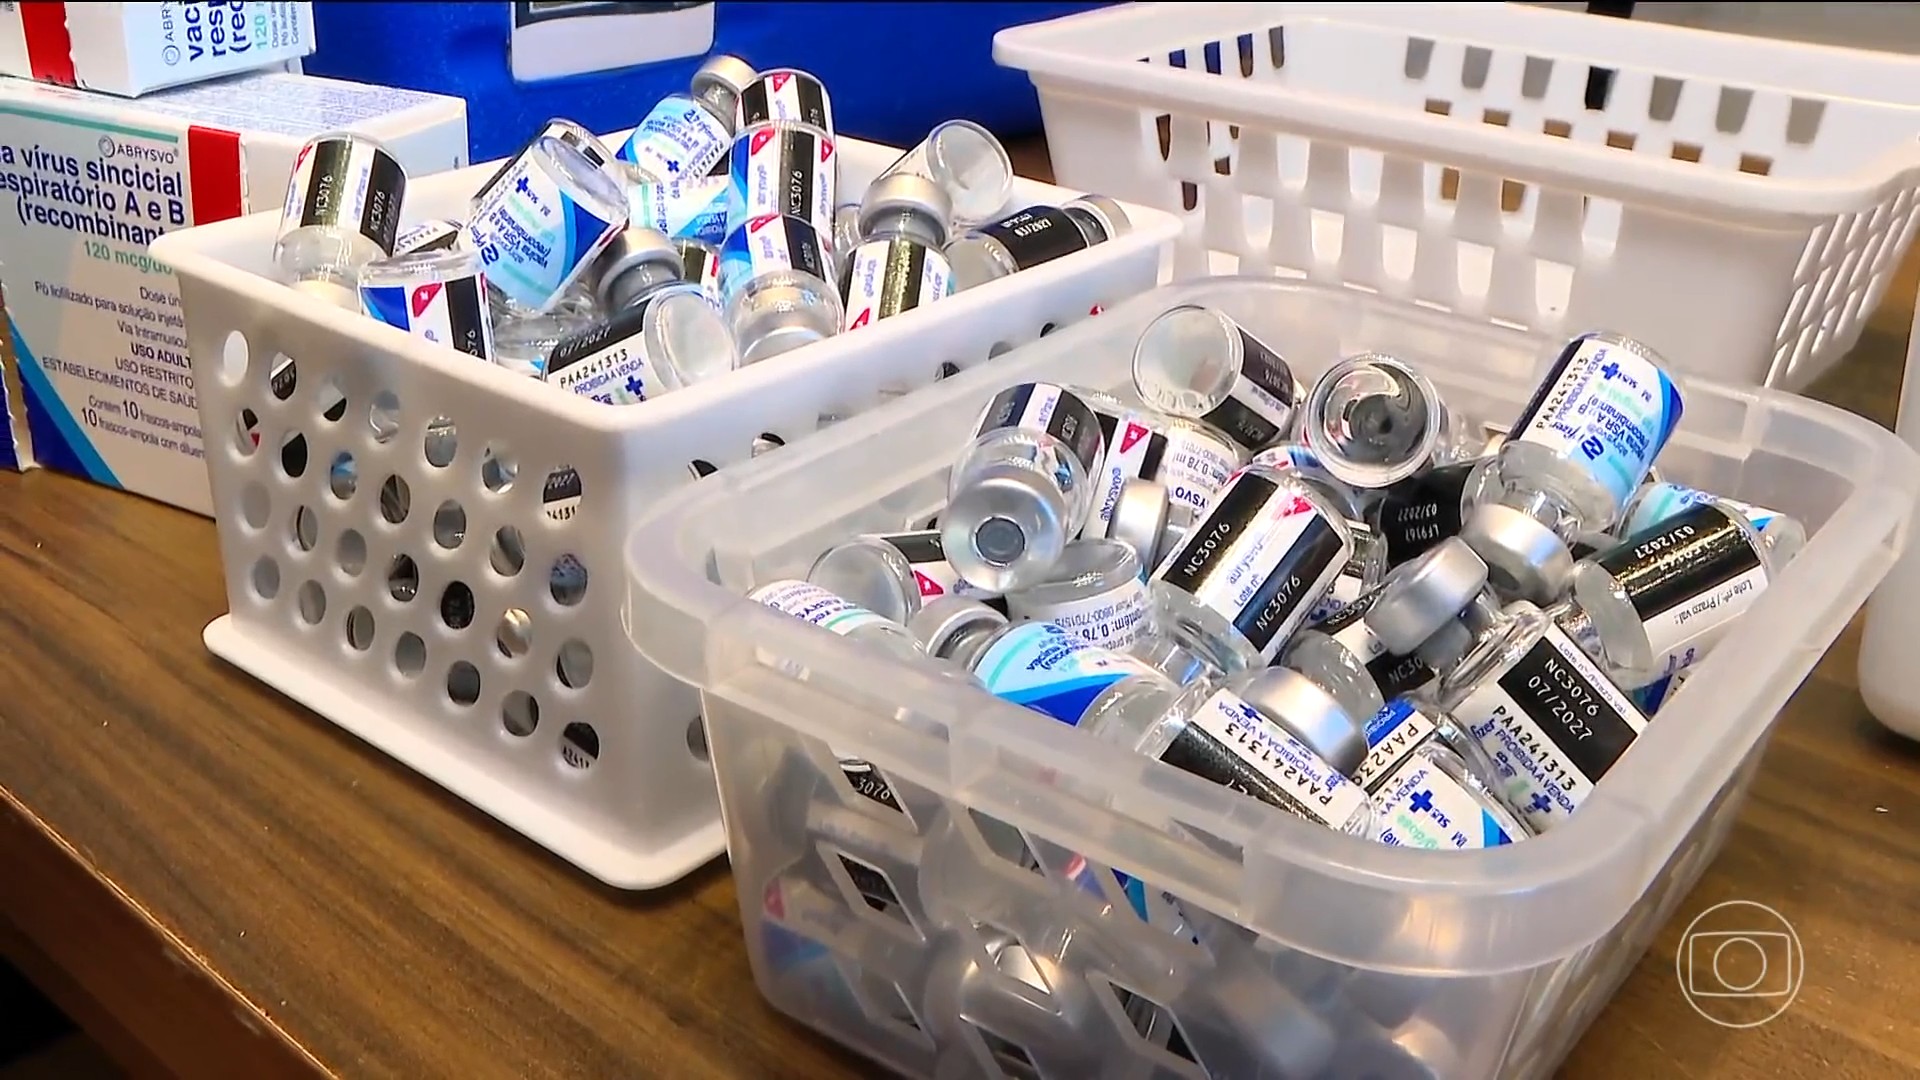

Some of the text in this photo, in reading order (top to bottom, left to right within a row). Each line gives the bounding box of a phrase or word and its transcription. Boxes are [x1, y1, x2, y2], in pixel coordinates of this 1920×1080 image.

[20, 144, 79, 177] vírus
[86, 157, 183, 198] sincicial
[125, 191, 141, 217] A
[147, 201, 162, 221] e
[169, 199, 185, 226] B
[84, 240, 110, 262] 120
[139, 286, 167, 304] Dose
[130, 342, 155, 360] USO
[559, 348, 629, 388] PAA241313
[42, 357, 150, 397] ESTABELECIMENTOS
[151, 385, 167, 401] DE
[114, 357, 194, 390] USO RESTRITO
[122, 399, 139, 420] 10
[1535, 356, 1589, 430] PAA241313
[81, 407, 98, 428] 10
[1183, 521, 1232, 578] NC3076
[1634, 525, 1696, 560] 03/2027
[1256, 574, 1302, 633] NC3076
[1691, 595, 1717, 616] Prazo
[1732, 578, 1753, 596] Lote
[1558, 642, 1577, 664] Lote
[1544, 658, 1600, 717] NC3076
[1217, 700, 1258, 738] VENDA
[1527, 674, 1594, 741] 07/2027
[1224, 722, 1333, 806] PAA241313
[1266, 734, 1322, 783] PROIBIDA
[1492, 704, 1577, 792] PAA241313
[1391, 768, 1429, 803] VENDA
[1494, 729, 1537, 780] PROIBIDA
[1543, 777, 1576, 815] VENDA
